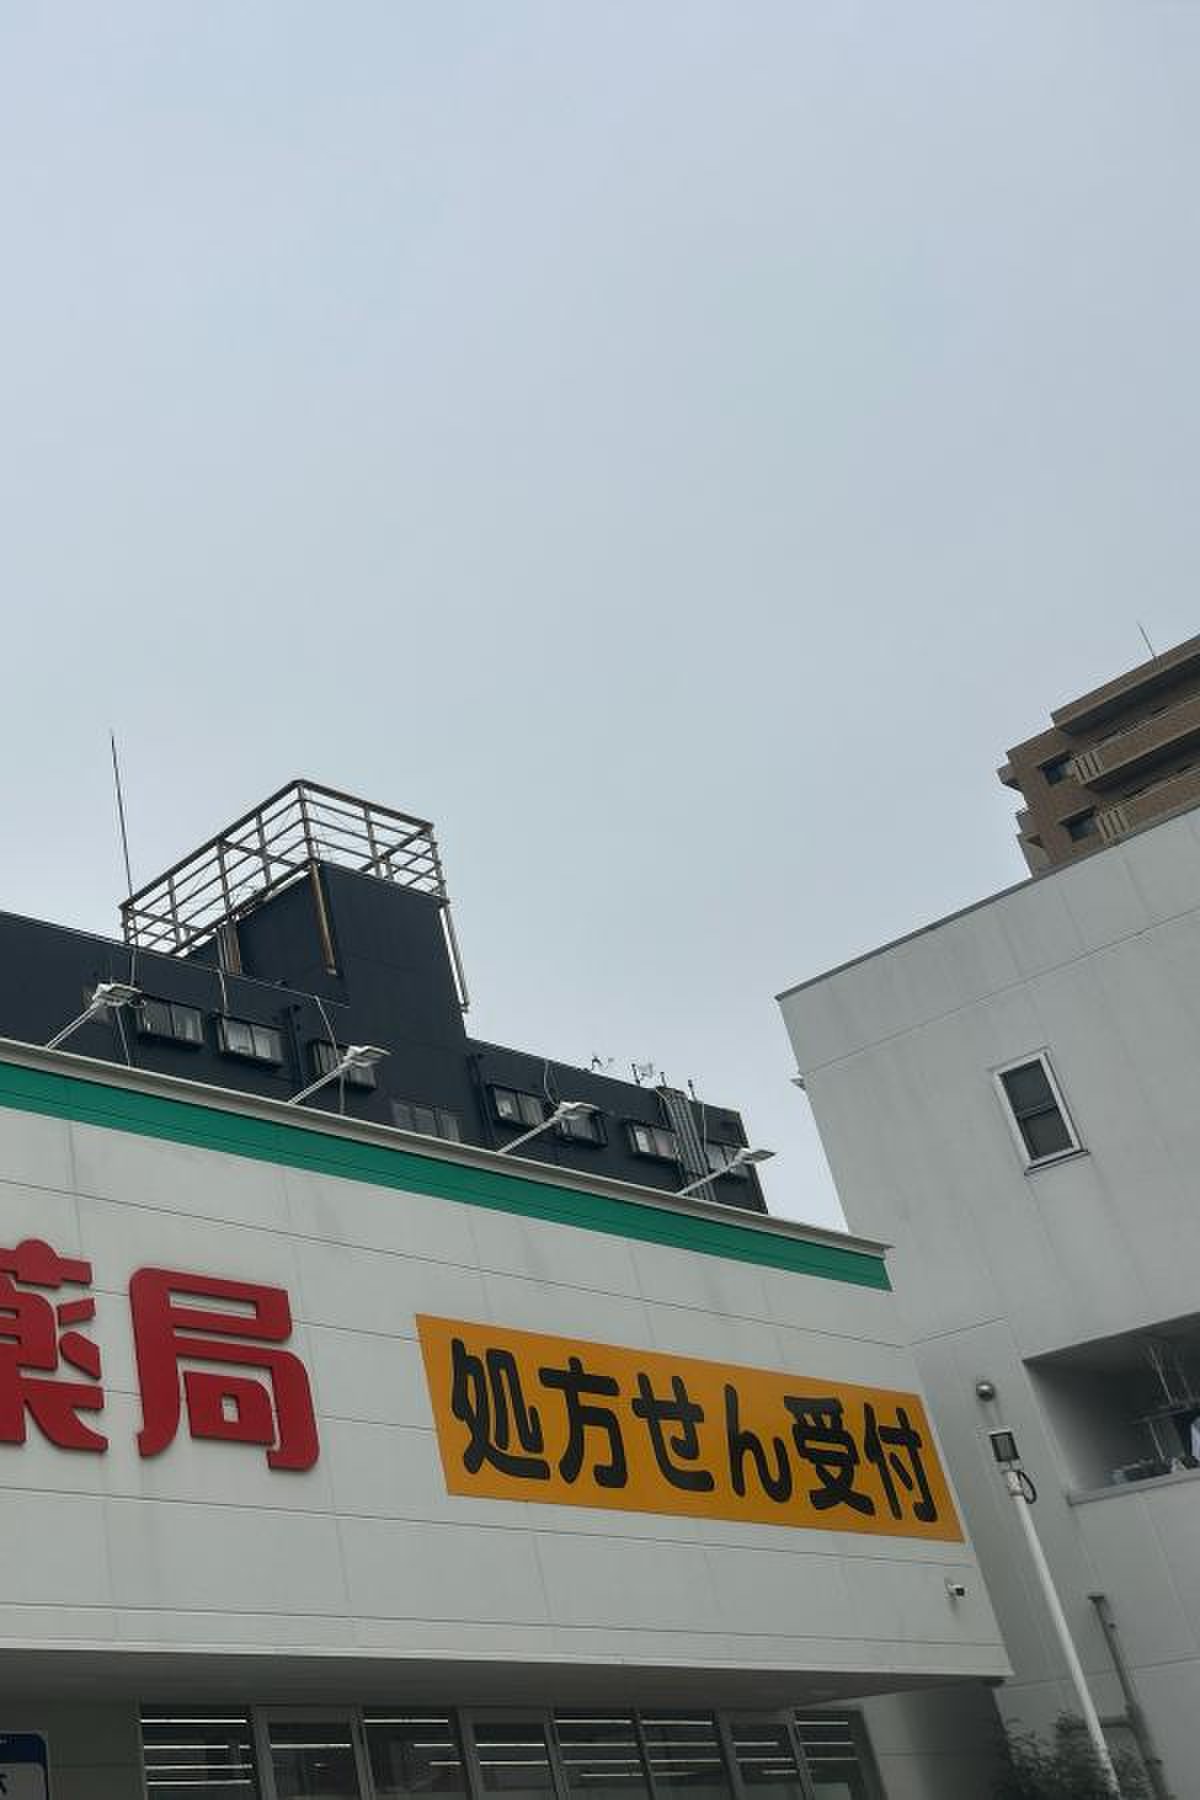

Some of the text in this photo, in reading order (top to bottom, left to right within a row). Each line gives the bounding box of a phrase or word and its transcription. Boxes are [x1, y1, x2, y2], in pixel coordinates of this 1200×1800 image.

[450, 1337, 939, 1524] 処方せん受付
